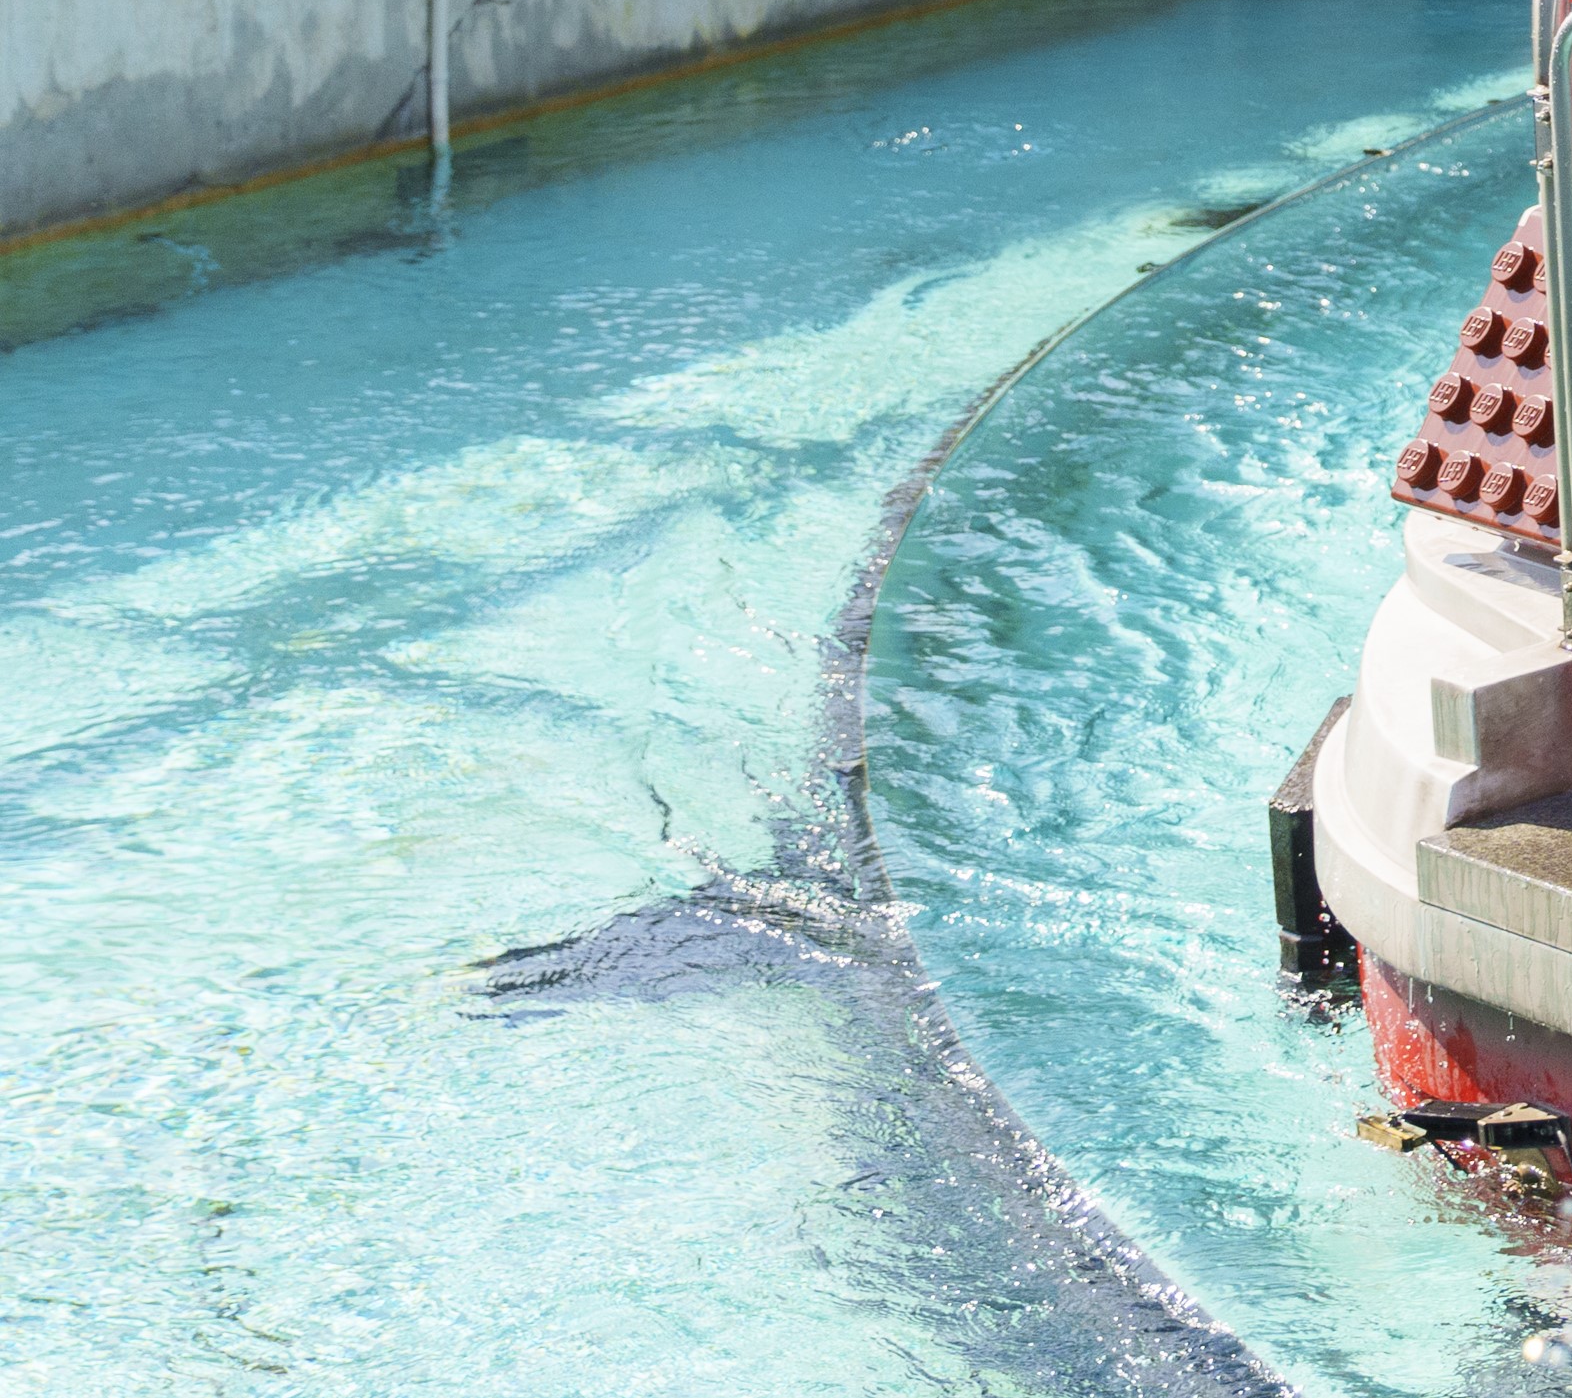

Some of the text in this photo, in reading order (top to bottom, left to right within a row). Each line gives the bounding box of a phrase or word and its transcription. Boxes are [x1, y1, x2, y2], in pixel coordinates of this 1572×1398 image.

[1461, 315, 1491, 339] LEGO
[1503, 327, 1533, 350] LEGO
[1472, 393, 1501, 416] LEGO
[1514, 405, 1543, 428] LEGO
[1481, 472, 1511, 495] LEGO
[1525, 484, 1555, 508] LEGO
